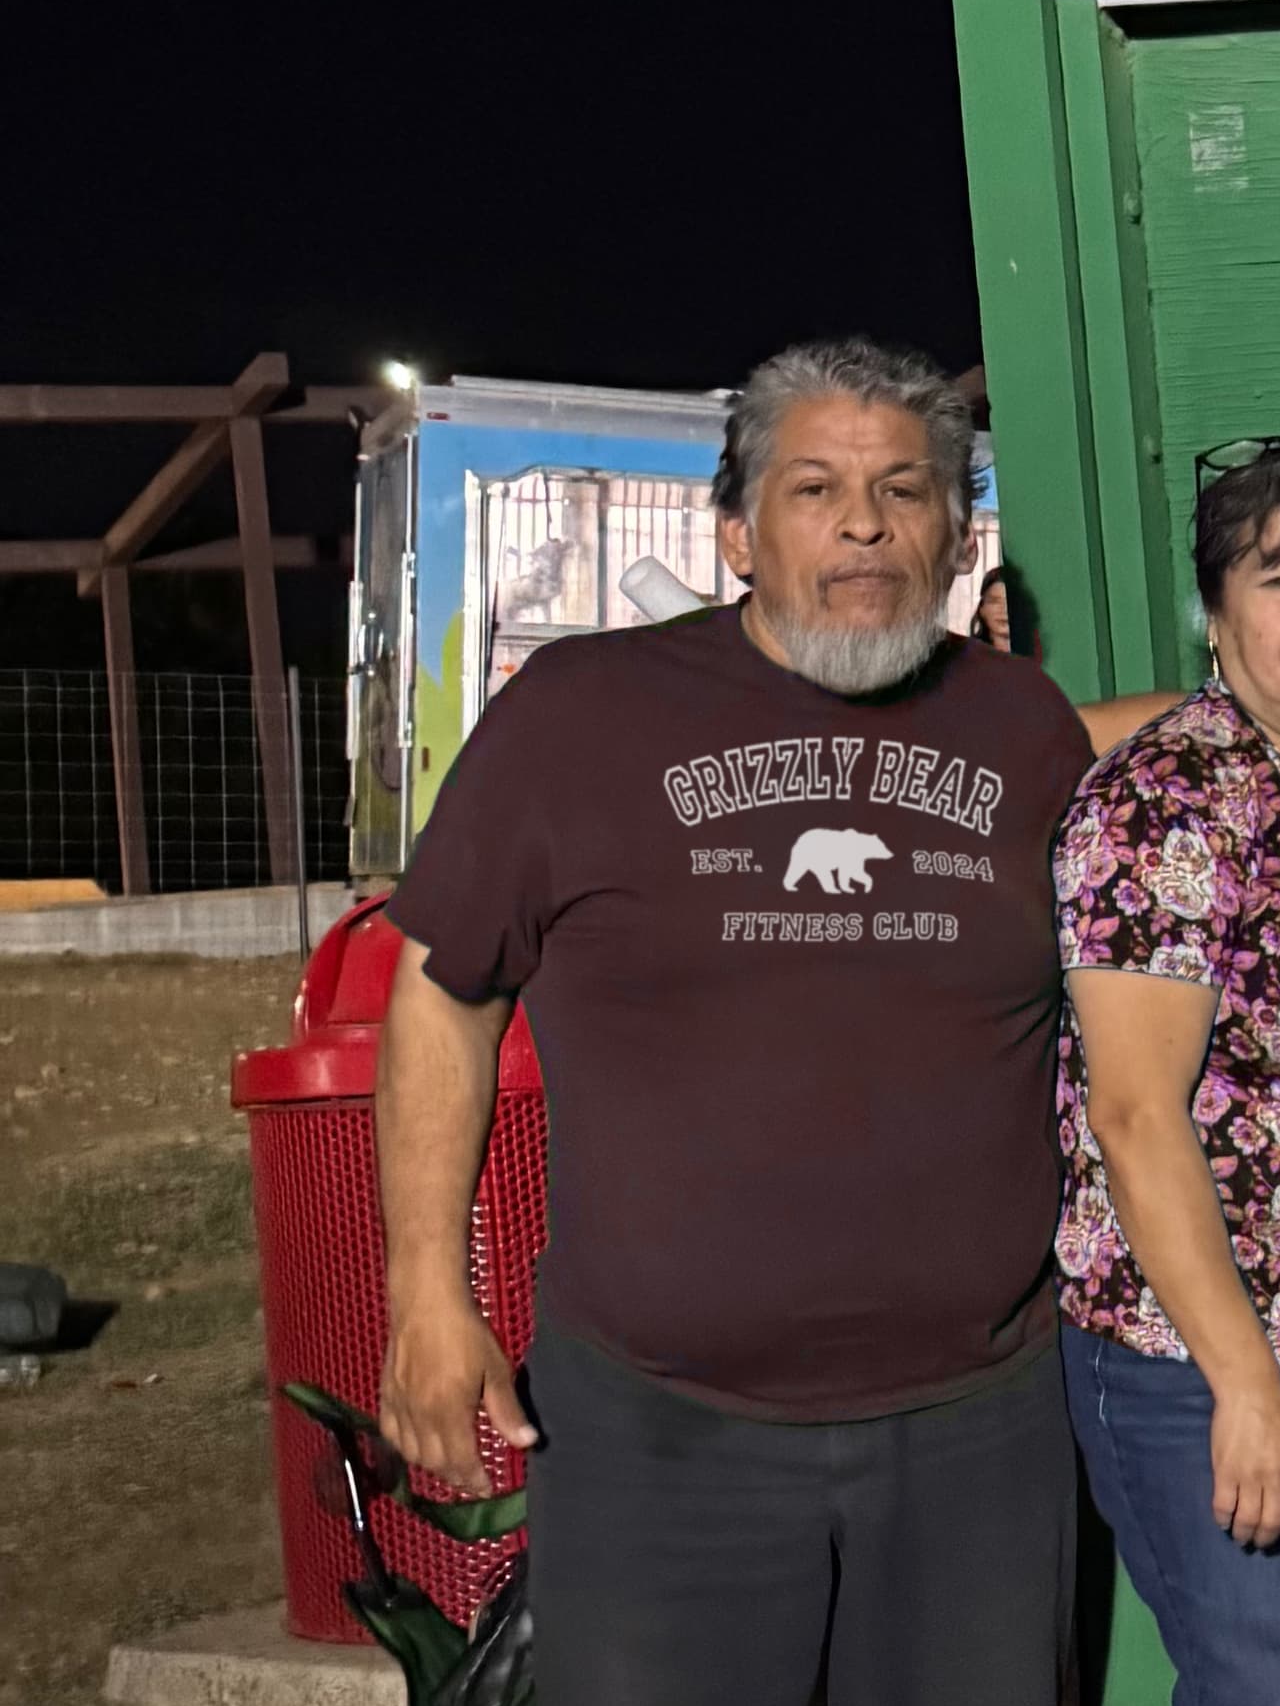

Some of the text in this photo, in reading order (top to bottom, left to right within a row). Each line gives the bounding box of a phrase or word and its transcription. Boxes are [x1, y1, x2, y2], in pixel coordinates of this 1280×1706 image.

[664, 737, 1003, 836] GRIZZLY BEAR
[690, 849, 763, 874] EST.
[913, 850, 994, 883] 2024
[722, 911, 958, 942] FITNESS CLUB
